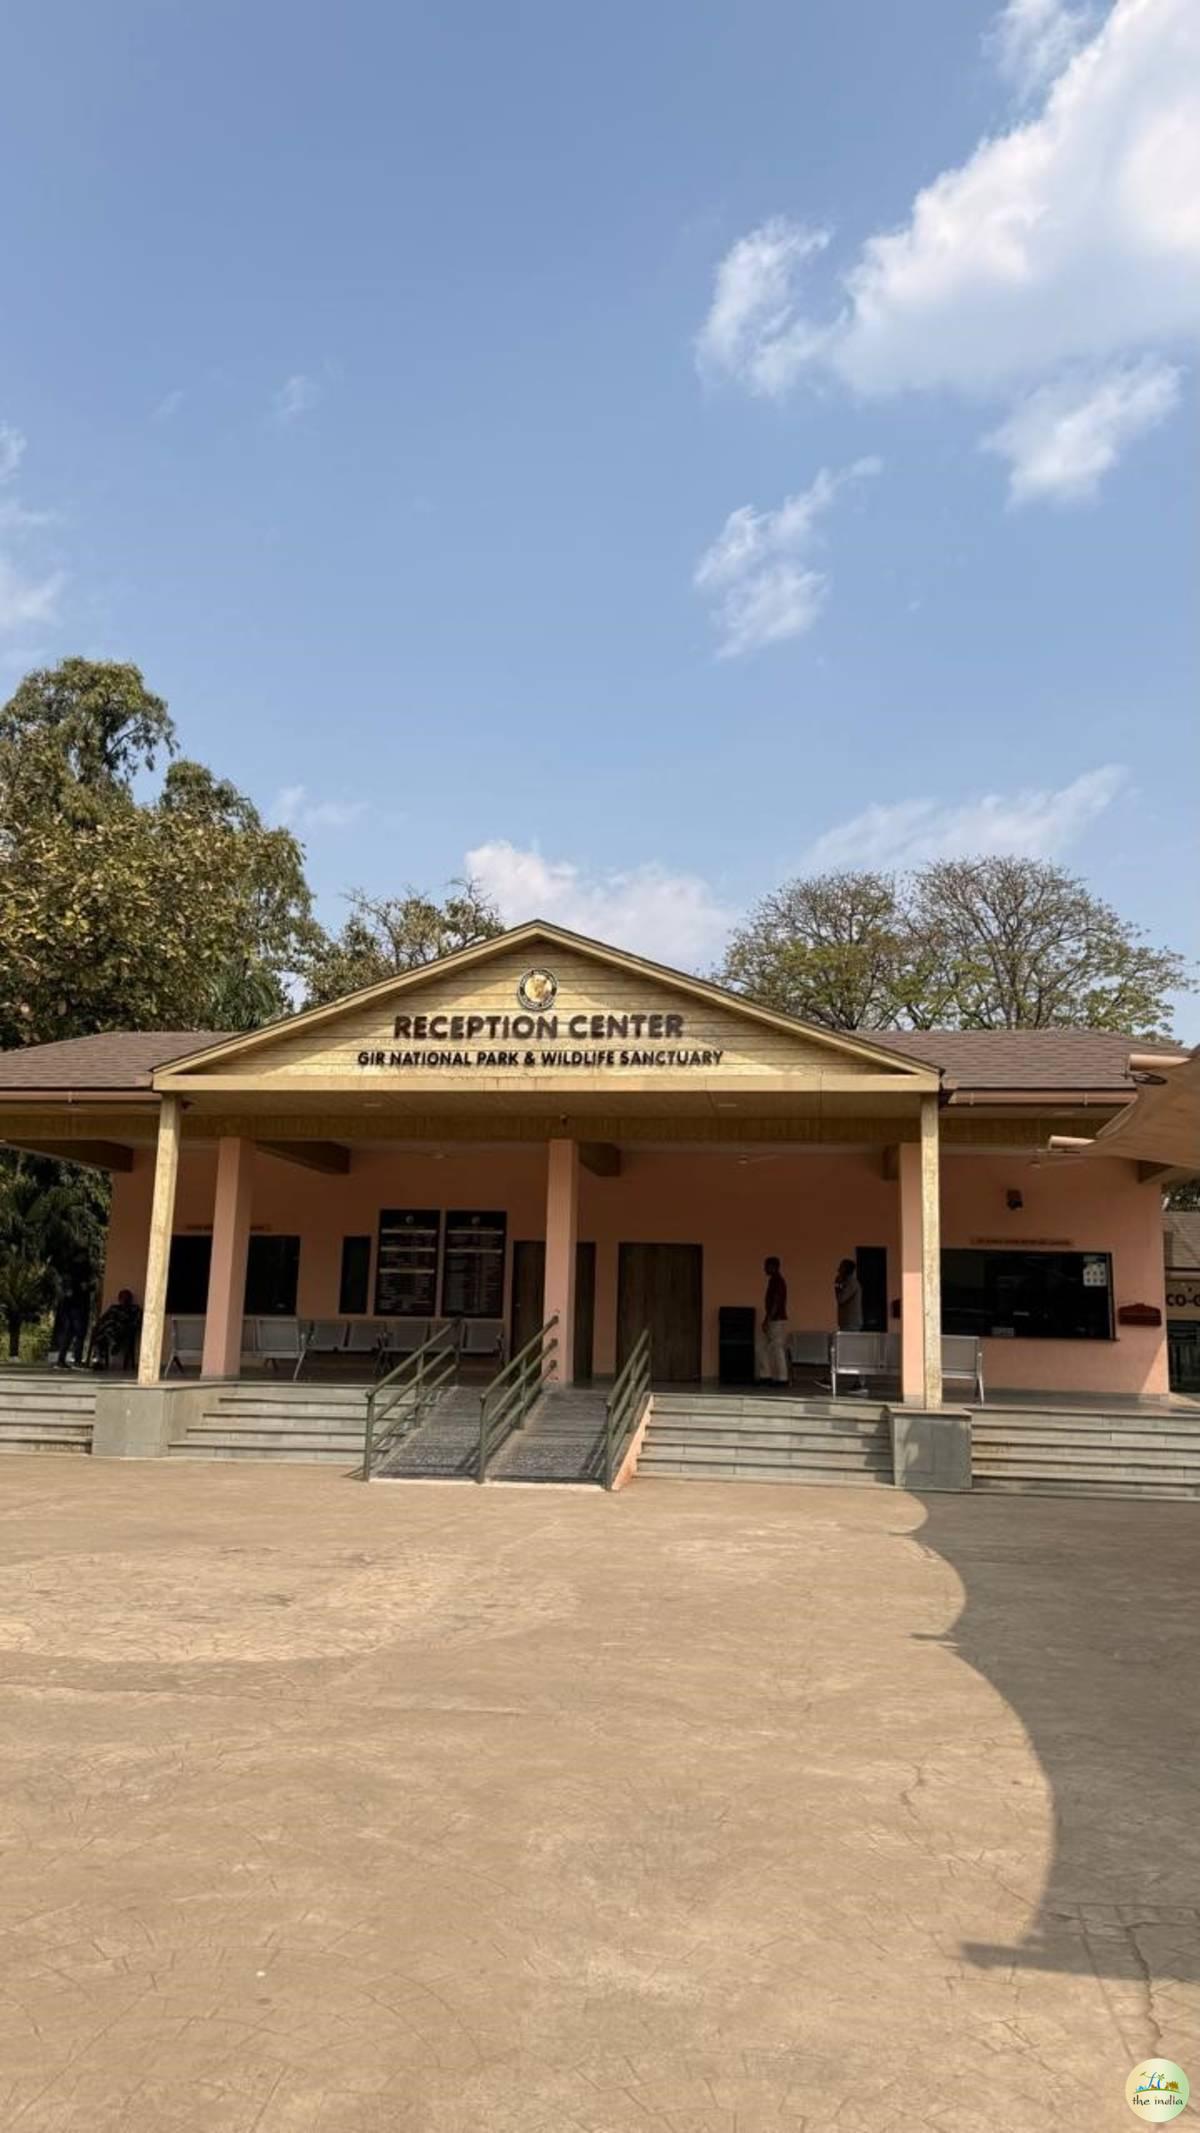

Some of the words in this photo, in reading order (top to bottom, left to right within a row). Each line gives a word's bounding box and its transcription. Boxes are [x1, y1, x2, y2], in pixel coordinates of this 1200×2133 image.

[394, 1015, 558, 1039] RECEPTION
[569, 1014, 684, 1038] CENTER
[358, 1051, 385, 1066] GIR
[390, 1051, 471, 1066] NATIONAL
[477, 1051, 519, 1066] PARK
[523, 1051, 535, 1066] &
[541, 1051, 615, 1066] WILDLIFE
[620, 1050, 723, 1066] SANCTUARY
